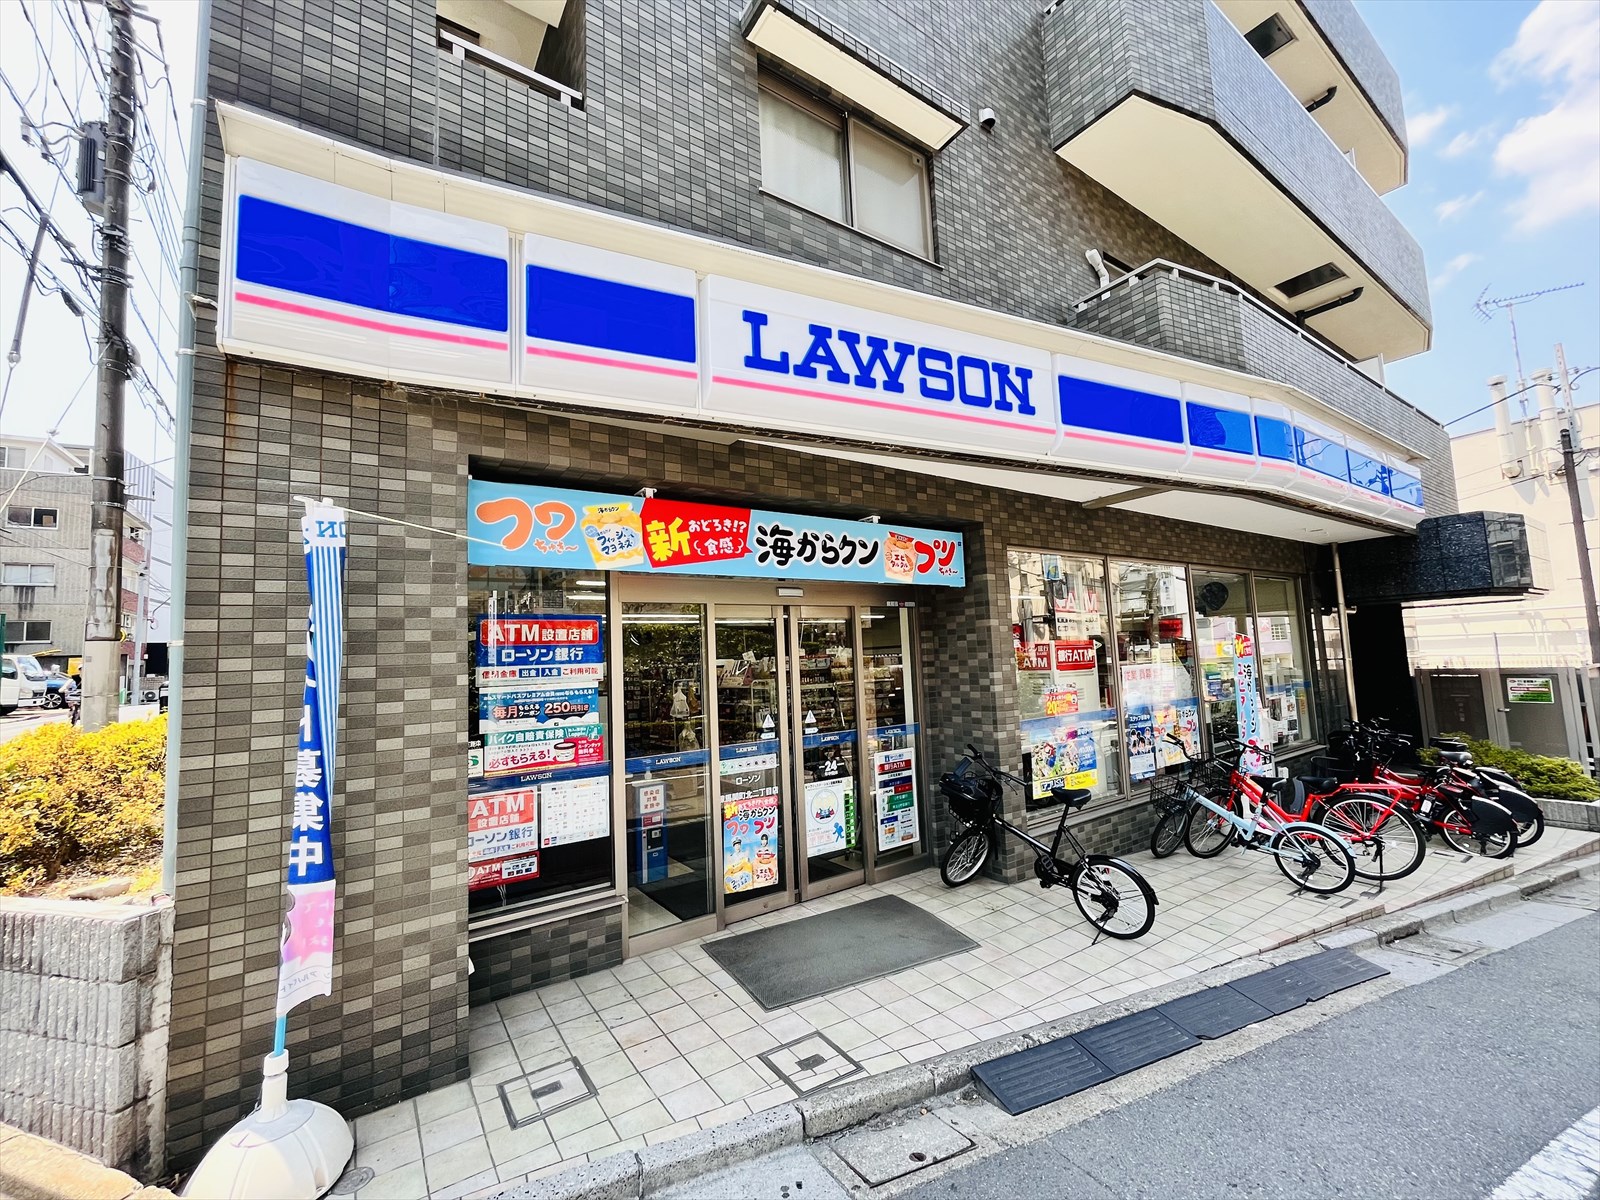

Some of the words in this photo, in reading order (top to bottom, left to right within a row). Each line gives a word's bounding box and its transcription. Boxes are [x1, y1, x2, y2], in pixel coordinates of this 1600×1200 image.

[742, 310, 1036, 415] LAWSON
[646, 516, 691, 562] 新
[704, 536, 735, 556] 食感
[755, 524, 879, 567] 海からクン
[501, 647, 584, 662] ローソン銀行
[1057, 649, 1094, 662] 銀行ATM
[1023, 657, 1048, 668] ATM
[521, 668, 537, 677] 出金
[543, 667, 559, 676] 入金
[562, 667, 599, 676] ご利用可能
[493, 705, 518, 718] 毎月
[544, 701, 590, 715] 250円引き
[489, 729, 565, 745] バイク自賠責保険
[488, 749, 551, 769] 必ずもらえる!
[655, 756, 682, 765] LAWSON
[824, 760, 838, 772] 24
[520, 772, 553, 782] LAWSON
[735, 774, 761, 786] ローソン
[720, 786, 779, 804] 町北二丁目店
[470, 793, 525, 819] ATM
[739, 806, 777, 820] 海からクン
[477, 813, 520, 829] 設置店舗
[476, 862, 501, 876] ATM
